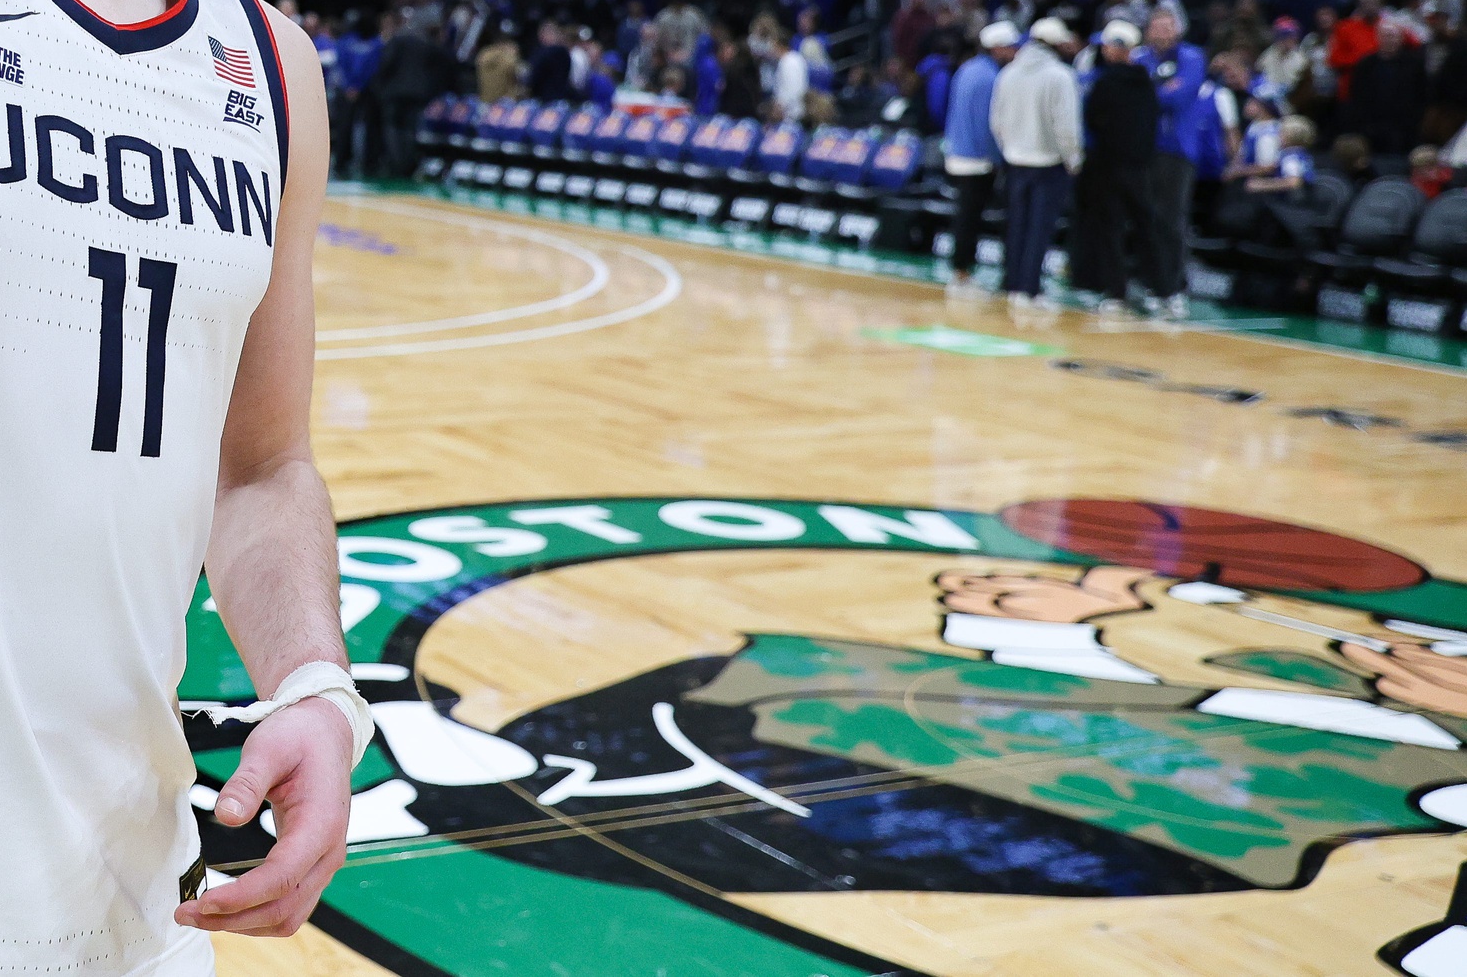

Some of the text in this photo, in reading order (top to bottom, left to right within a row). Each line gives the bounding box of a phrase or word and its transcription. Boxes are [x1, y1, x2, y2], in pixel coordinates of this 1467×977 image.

[227, 89, 257, 110] BIG
[224, 103, 265, 126] EAST
[88, 245, 179, 458] 11
